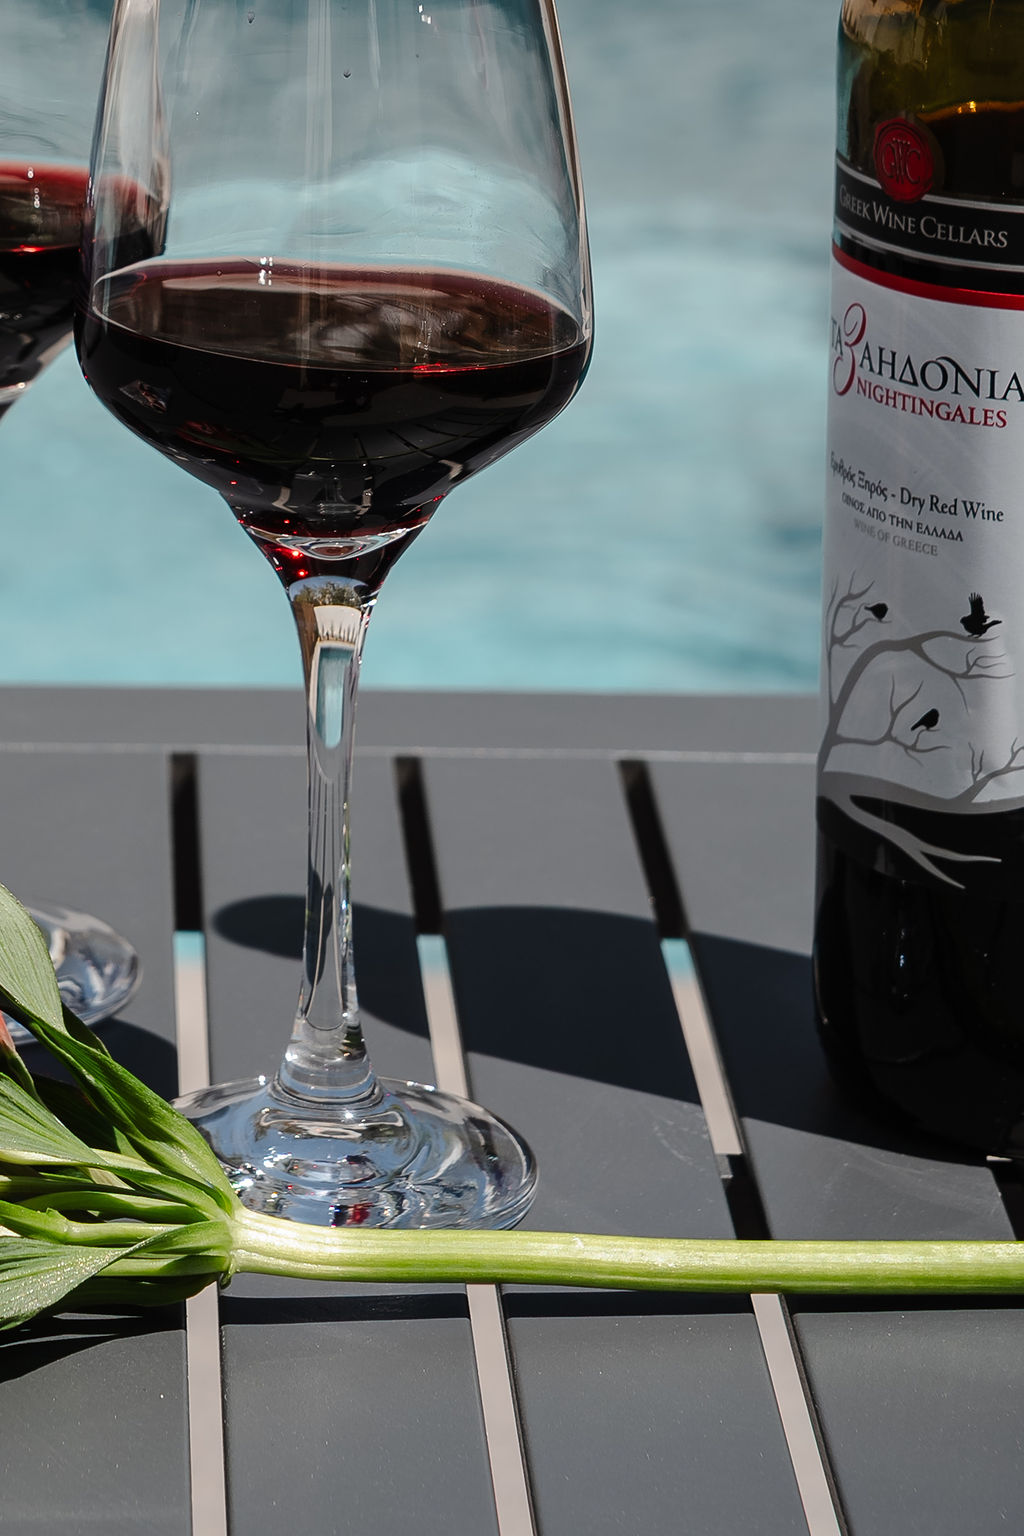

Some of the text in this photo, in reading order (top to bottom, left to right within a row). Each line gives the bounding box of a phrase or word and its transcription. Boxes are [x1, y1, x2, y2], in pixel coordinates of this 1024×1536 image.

[839, 184, 1009, 248] GREEK WINE CELLARS
[857, 376, 1008, 428] NIGHTINGALES
[858, 469, 888, 502] Ξηρός
[900, 486, 925, 515] Dry
[929, 494, 958, 516] Red
[961, 499, 1004, 522] Wine
[877, 529, 891, 543] OF
[892, 535, 939, 557] GREECE
